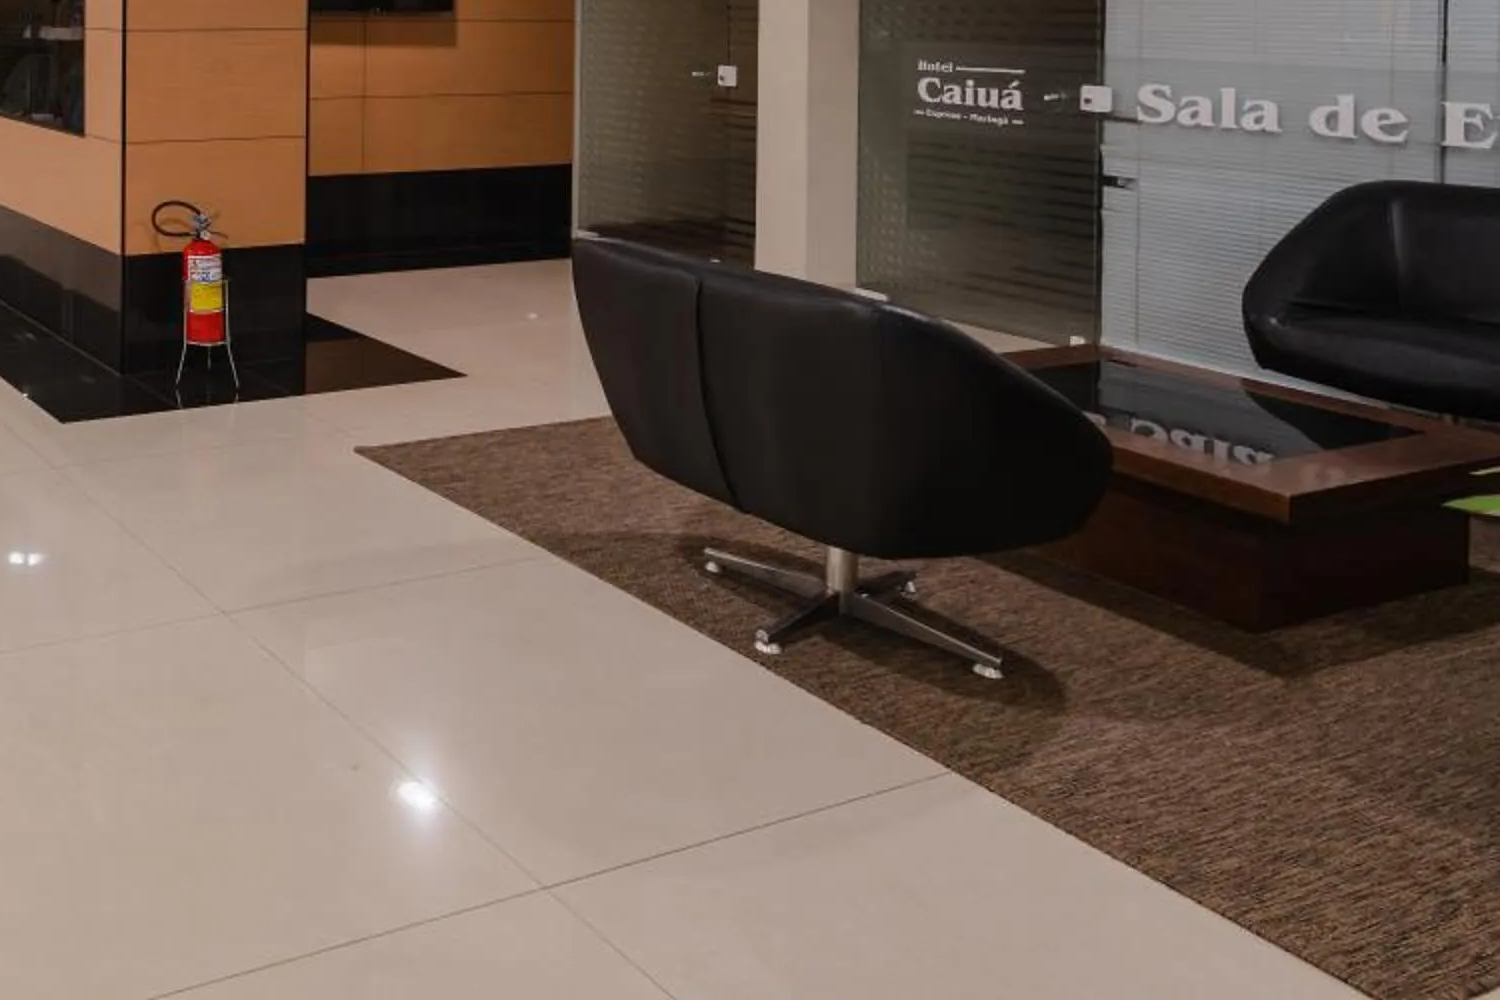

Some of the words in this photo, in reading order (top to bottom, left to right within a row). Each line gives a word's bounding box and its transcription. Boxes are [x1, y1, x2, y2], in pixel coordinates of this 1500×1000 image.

[917, 77, 1024, 110] Caiuá
[1136, 83, 1283, 134] Sala
[1308, 94, 1410, 144] de
[1441, 101, 1500, 149] E
